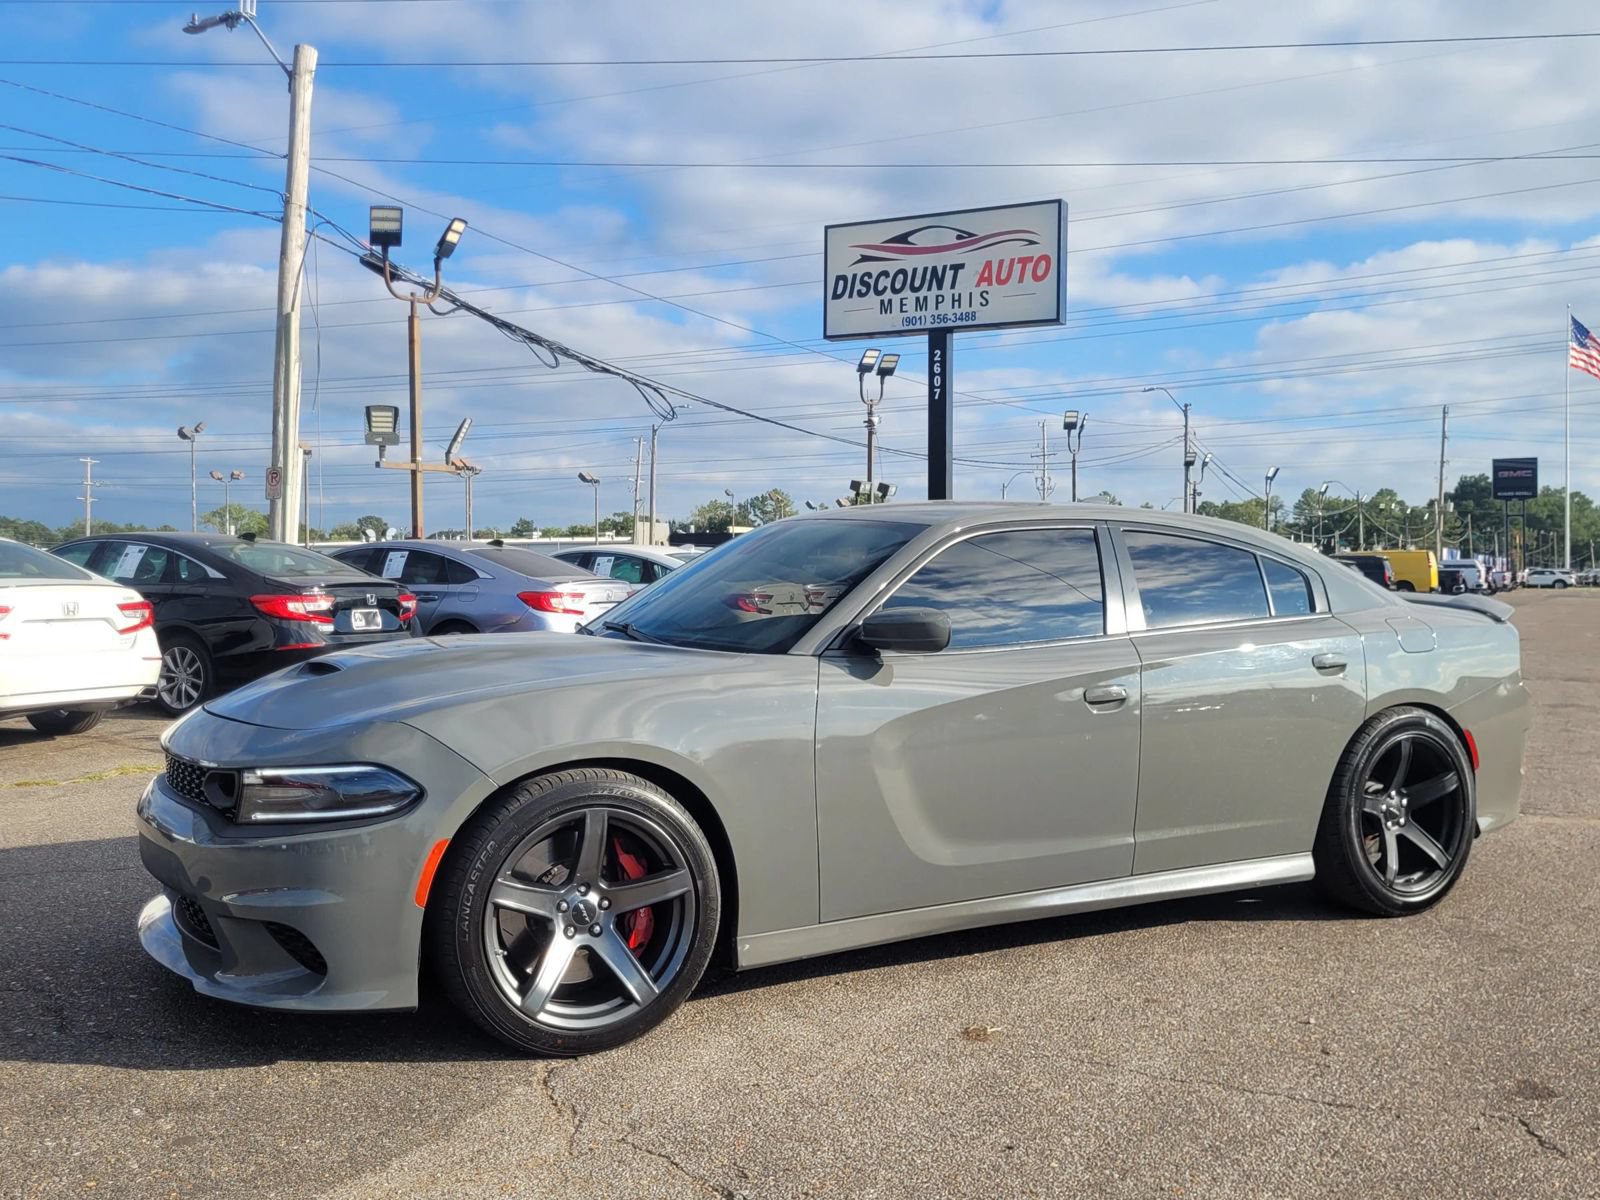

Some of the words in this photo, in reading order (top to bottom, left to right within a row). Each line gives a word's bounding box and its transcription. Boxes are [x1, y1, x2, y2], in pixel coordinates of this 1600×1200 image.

[831, 263, 965, 300] DISCOUNT
[975, 254, 1052, 288] AUTO
[879, 290, 990, 315] MEMPHIS
[901, 315, 927, 327] (901)
[930, 311, 977, 325] 356-3488
[933, 350, 942, 400] 2607
[1498, 470, 1533, 478] GMC
